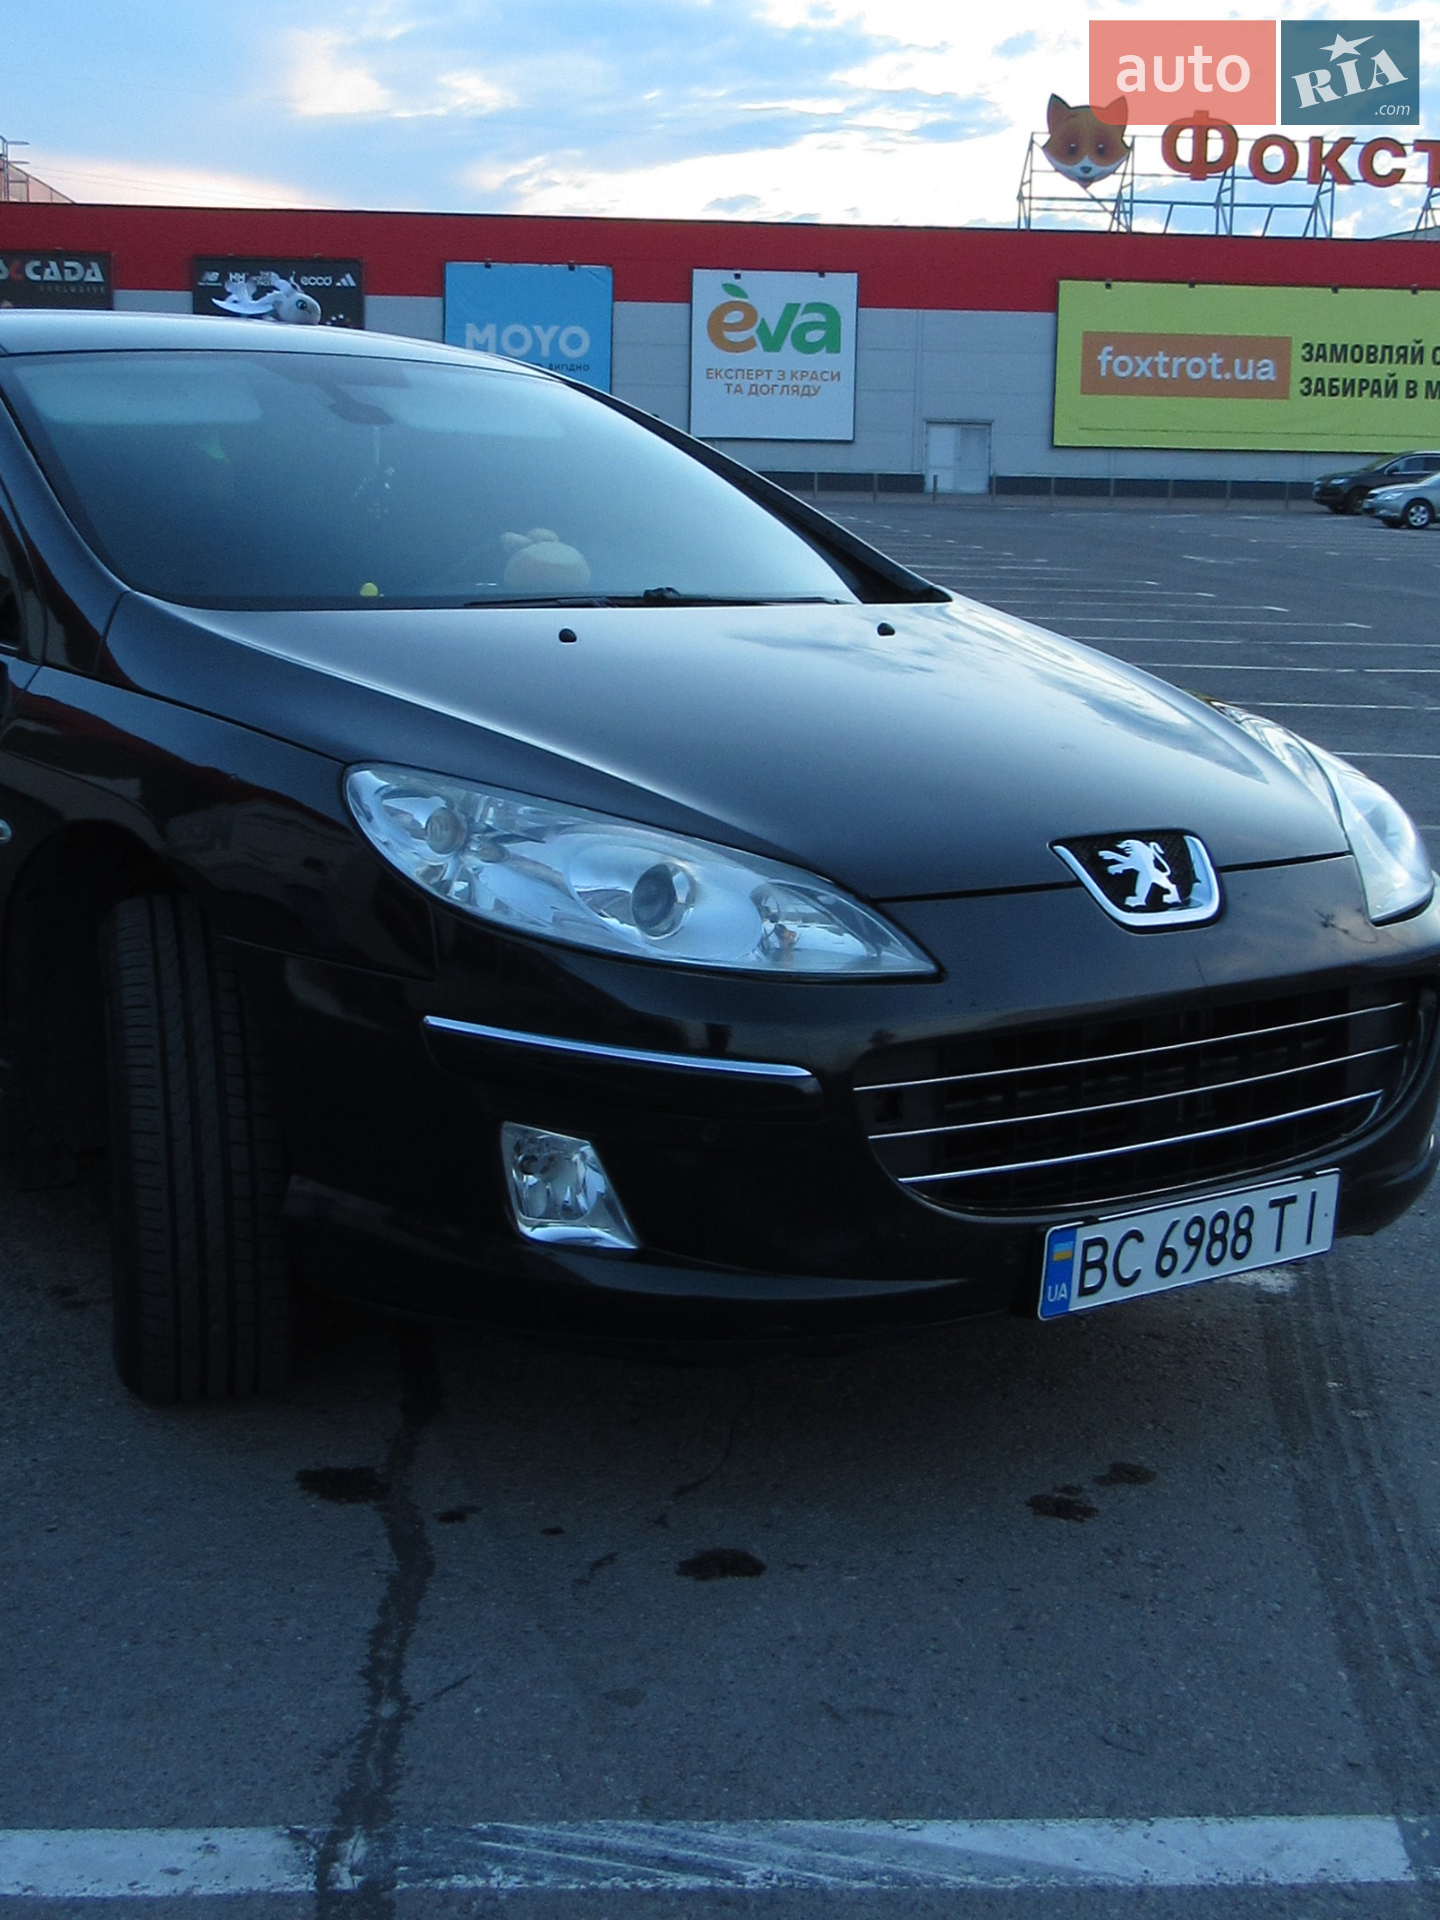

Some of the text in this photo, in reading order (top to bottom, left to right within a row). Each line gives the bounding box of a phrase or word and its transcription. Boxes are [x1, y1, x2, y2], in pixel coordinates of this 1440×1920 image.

[300, 276, 332, 286] ecco
[464, 323, 591, 358] MOYO
[1301, 338, 1424, 365] ЗАМОВЛЯЙ
[705, 368, 841, 382] ЕКСПЕРТ З КРАСИ
[1097, 346, 1275, 382] foxtrot.ua
[724, 383, 821, 397] ТА ДОГЛЯДУ
[1299, 372, 1398, 398] ЗАБИРАЙ
[1405, 379, 1418, 399] В
[1077, 1190, 1317, 1297] BC 6988 TI
[1047, 1282, 1068, 1303] UA
